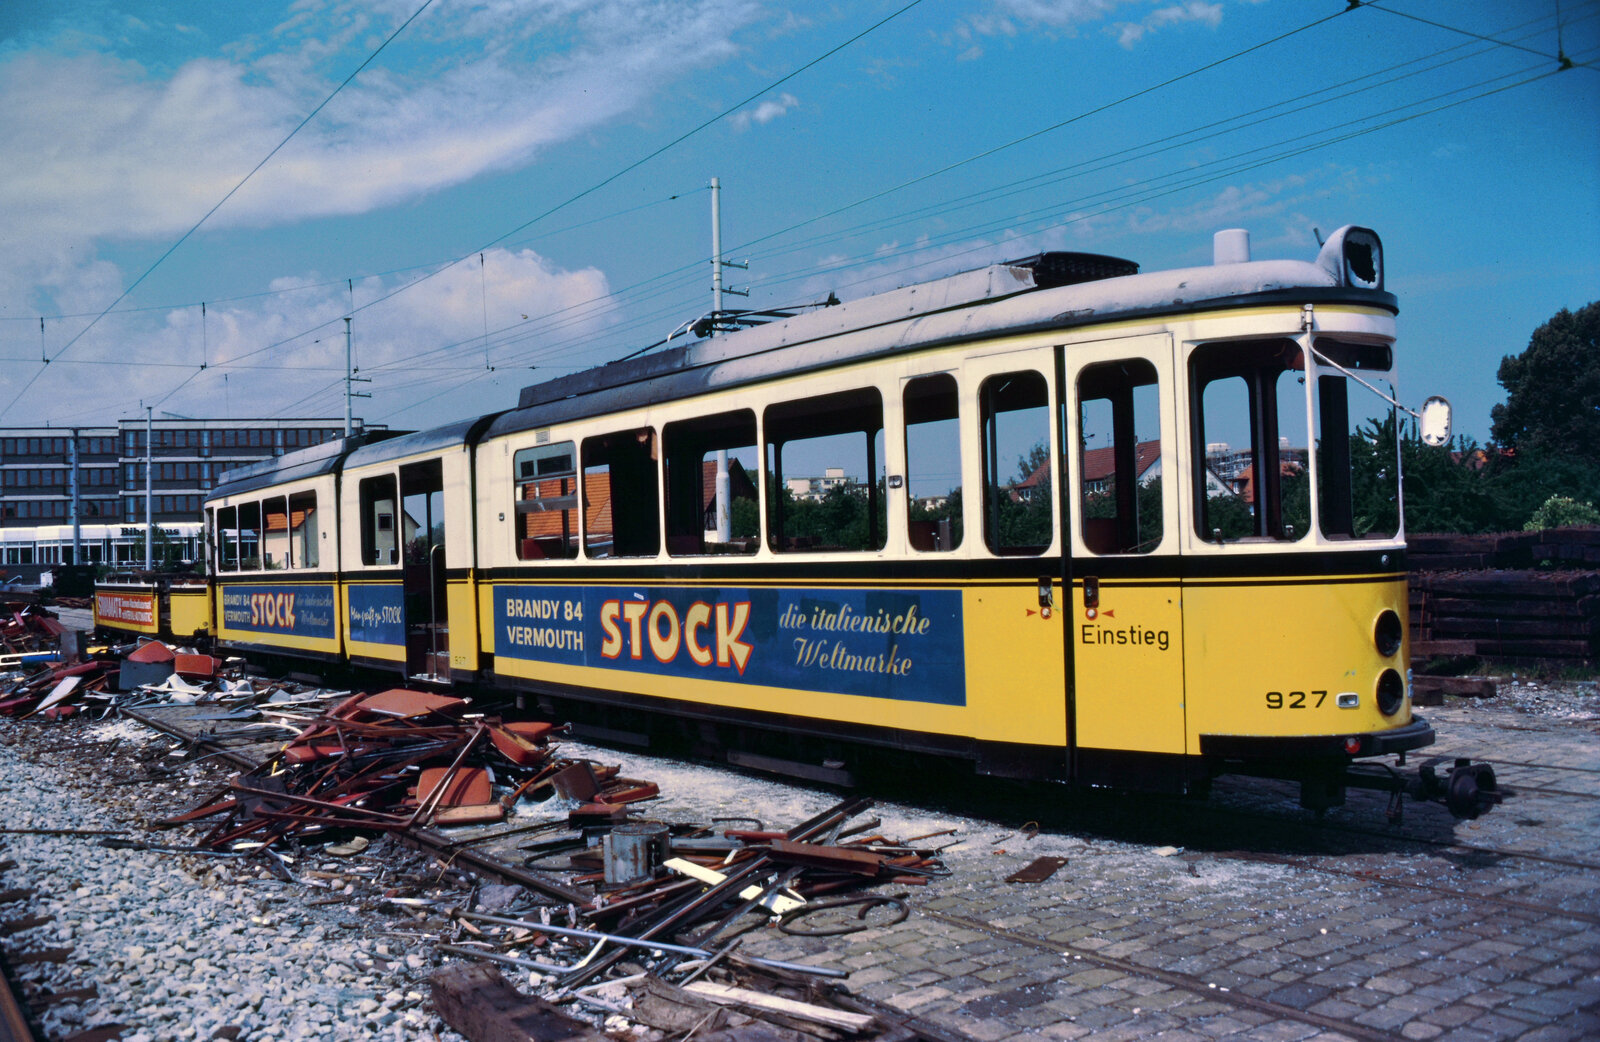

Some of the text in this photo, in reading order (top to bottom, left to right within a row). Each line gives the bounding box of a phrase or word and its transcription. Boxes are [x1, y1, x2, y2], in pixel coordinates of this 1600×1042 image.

[121, 527, 180, 536] Bibeaus
[225, 611, 250, 623] VERMOUTH
[250, 592, 296, 630] STOCK
[382, 606, 402, 624] STOCK
[506, 598, 584, 622] BRANDY 84
[779, 603, 931, 636] die italienische
[507, 625, 584, 652] VERMOUTH
[600, 599, 754, 676] STOCK
[1081, 624, 1170, 651] Einstieg
[793, 637, 912, 677] Weltmarke
[1266, 690, 1328, 709] 927
